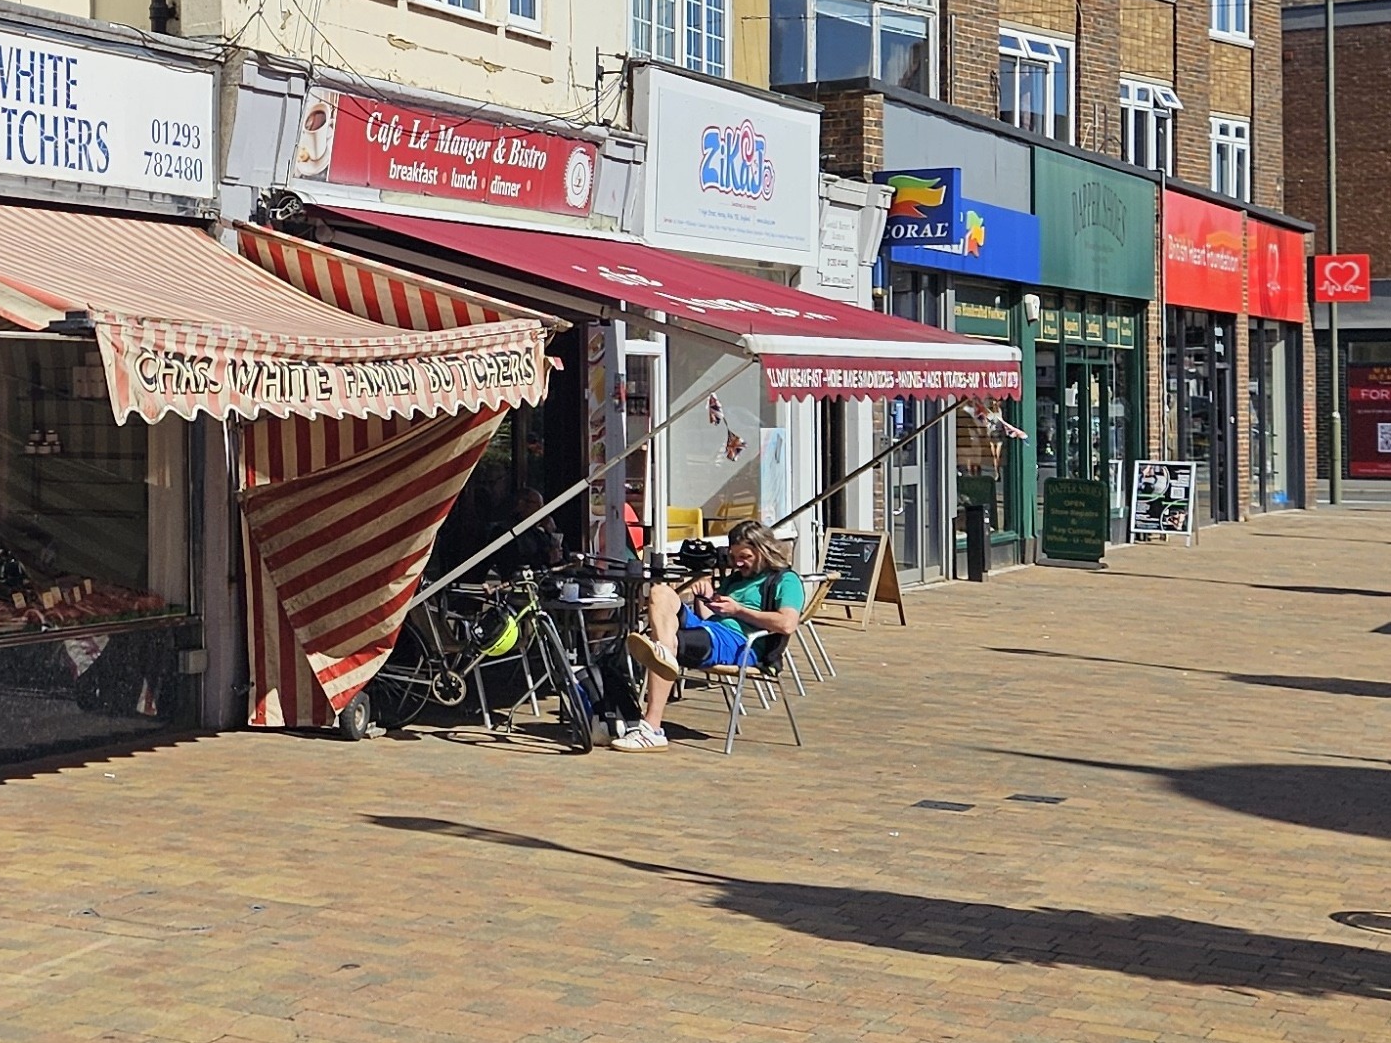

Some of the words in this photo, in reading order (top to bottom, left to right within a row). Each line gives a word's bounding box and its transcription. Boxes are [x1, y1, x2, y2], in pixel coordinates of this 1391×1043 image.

[151, 118, 202, 149] 01293
[408, 119, 430, 150] Le
[434, 124, 492, 165] Manger
[493, 137, 506, 164] &
[508, 142, 547, 171] Bistro
[143, 150, 203, 183] 782480
[389, 158, 438, 186] breakfast
[451, 167, 477, 191] lunch
[490, 176, 521, 198] dinner
[227, 360, 333, 402] WHITE
[343, 358, 420, 399] FAMILY
[426, 349, 535, 394] BUTCHERS
[1360, 388, 1391, 400] FOR
[1063, 499, 1085, 508] OPEN
[1070, 509, 1099, 518] Repairs
[1067, 527, 1096, 537] Cutting
